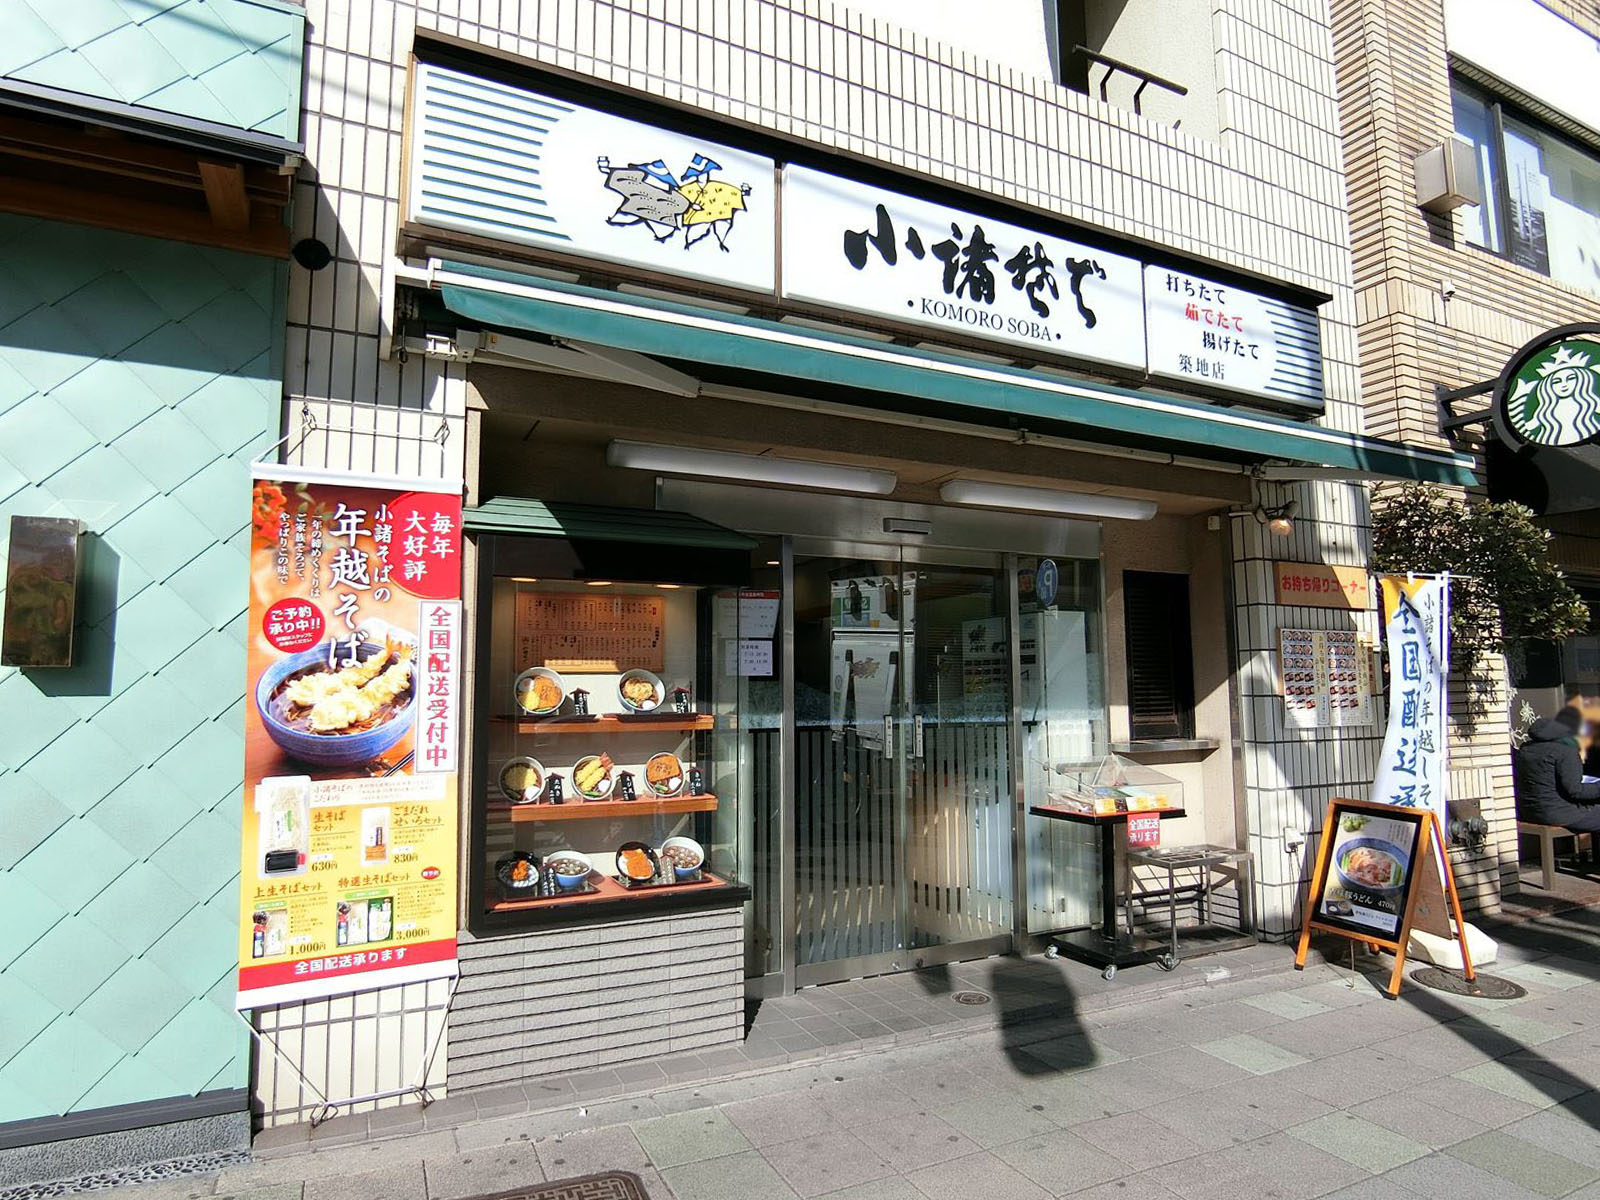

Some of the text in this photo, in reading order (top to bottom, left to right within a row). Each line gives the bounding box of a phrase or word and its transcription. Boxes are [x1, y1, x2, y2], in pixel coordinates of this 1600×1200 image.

[1166, 274, 1226, 305] 打ちたて
[921, 297, 1051, 341] KOMORO SOBA
[1185, 303, 1244, 333] 茹でたて
[1203, 332, 1260, 361] 揚げたて
[1179, 354, 1226, 380] 築地店
[403, 511, 429, 581] 大好評
[430, 512, 454, 559] 毎年
[373, 504, 394, 602] 小諸そばの
[329, 503, 372, 669] 年越そば
[1282, 575, 1366, 593] お持ち帰りコーナー
[271, 605, 312, 620] ご予約
[426, 606, 451, 767] 全国配送受付中
[313, 810, 347, 823] 生そば
[313, 823, 334, 832] セット
[1129, 818, 1160, 831] 全国配送
[1129, 830, 1160, 844] 承ります
[254, 882, 323, 898] 上生そばセット
[295, 947, 407, 976] 全国配送承ります
